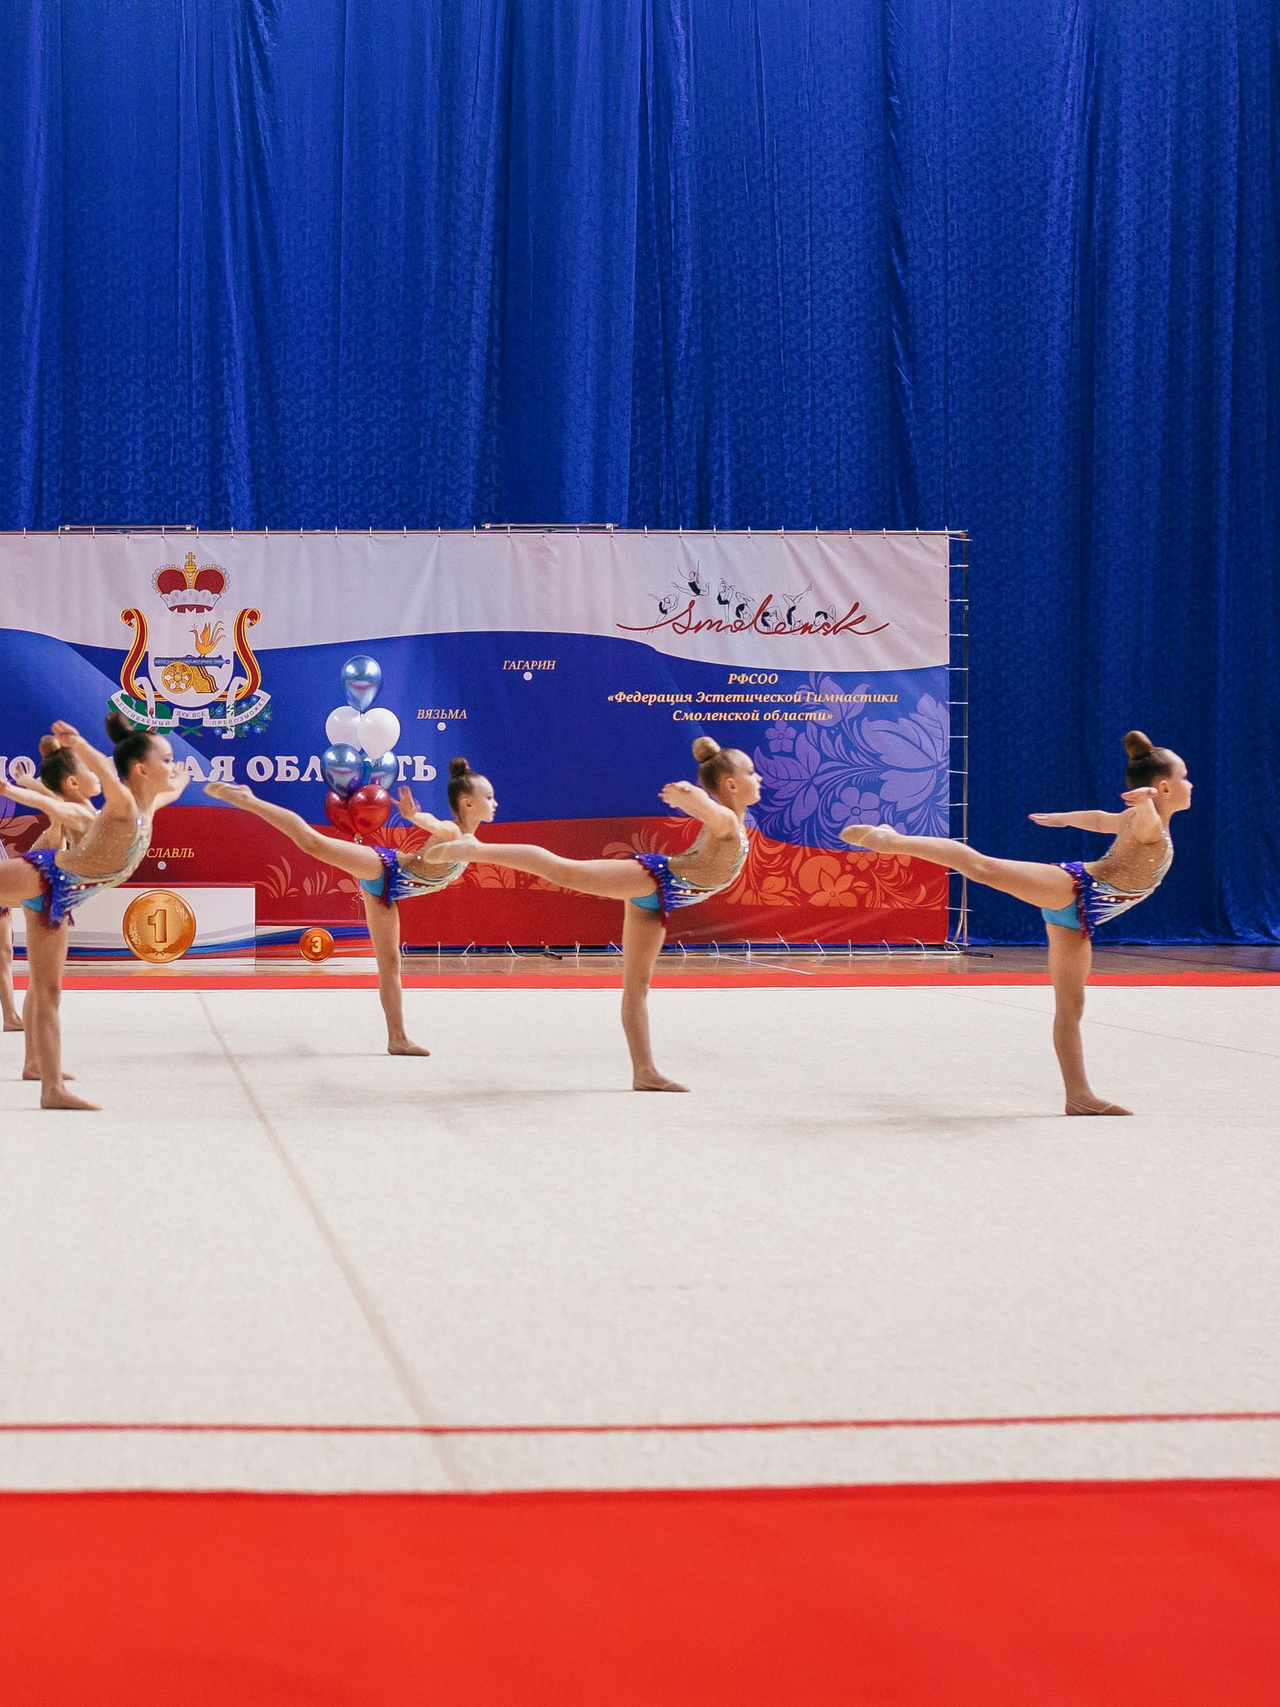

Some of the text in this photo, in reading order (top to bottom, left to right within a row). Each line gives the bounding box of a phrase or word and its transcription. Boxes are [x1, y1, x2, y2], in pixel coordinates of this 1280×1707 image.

[616, 594, 890, 636] Smolensk
[502, 660, 557, 670] ГАГАРИН
[727, 673, 779, 685] РФСОО
[607, 691, 899, 706] «Федерация Эстетической Гимнастики
[417, 709, 467, 720] ВЯЗЬМА
[672, 709, 833, 721] Смоленской области»
[246, 755, 437, 782] ОБЛТЬ
[146, 847, 195, 858] СЛАВЛЬ
[147, 909, 167, 943] 1
[311, 936, 322, 953] 3
